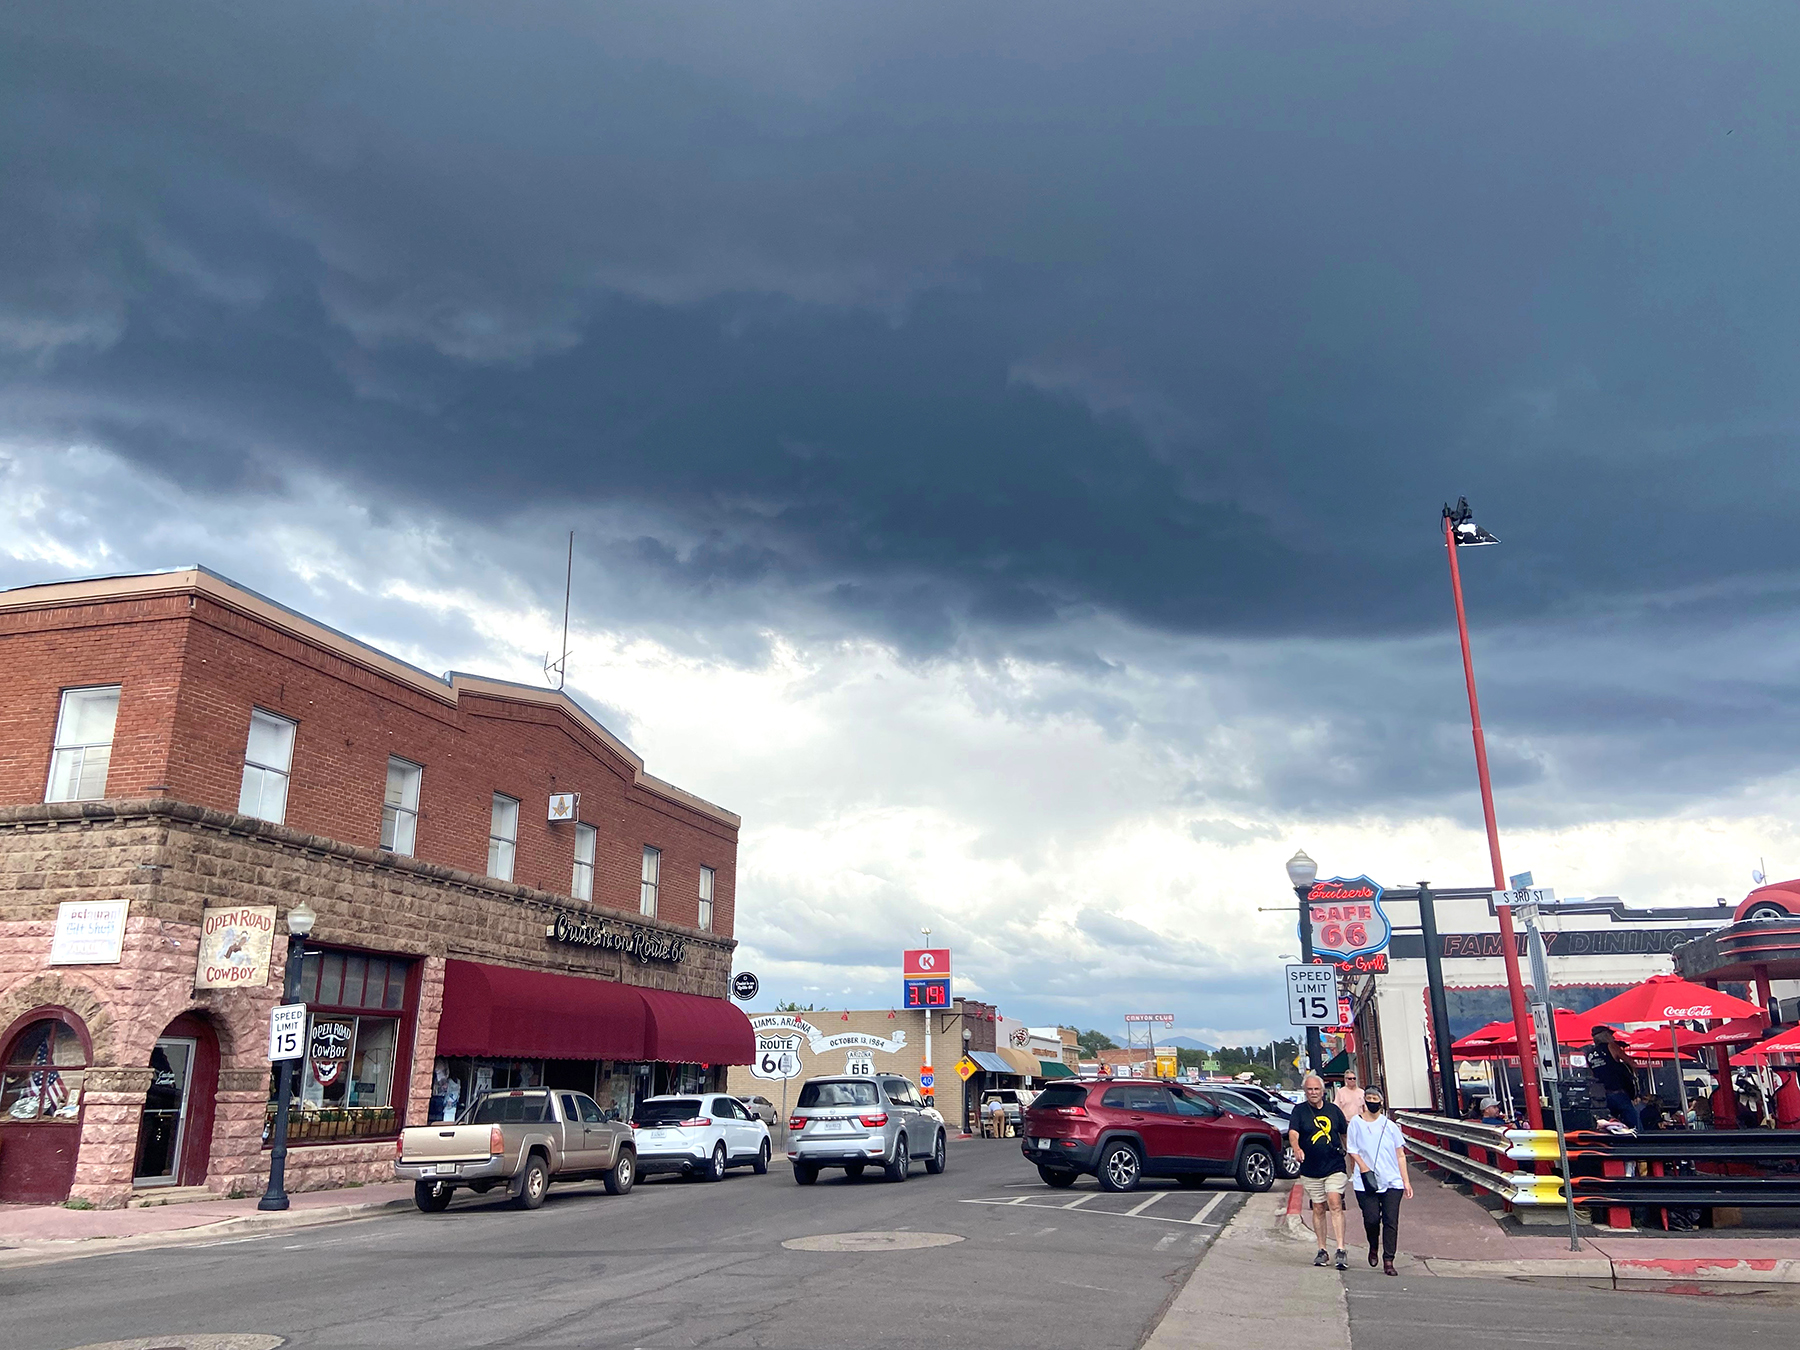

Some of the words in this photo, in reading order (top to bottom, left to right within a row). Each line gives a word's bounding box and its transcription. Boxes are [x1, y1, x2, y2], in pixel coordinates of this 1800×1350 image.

[1307, 882, 1374, 900] Cruiser's
[1503, 892, 1510, 904] S
[1513, 891, 1530, 903] 3RD
[1533, 890, 1544, 902] ST
[1310, 905, 1372, 922] CAFE
[205, 912, 239, 935] OPEN
[240, 910, 272, 932] ROAD
[1320, 922, 1368, 948] 66
[1568, 931, 1687, 954] DINING
[632, 931, 670, 963] Route
[671, 940, 687, 962] 66
[1355, 953, 1386, 972] Grill
[1290, 971, 1332, 981] SPEED
[1295, 984, 1327, 993] LIMIT
[1298, 996, 1329, 1019] 15
[1663, 1005, 1713, 1017] Coca-Cola
[274, 1010, 303, 1021] SPEED
[276, 1021, 299, 1032] LIMIT
[312, 1023, 332, 1040] OPEN
[333, 1023, 352, 1040] ROAD
[276, 1033, 297, 1053] 15
[760, 1040, 793, 1050] ROUTE
[829, 1036, 859, 1047] OCTOBER
[868, 1038, 885, 1048] 1984
[851, 1063, 869, 1075] 66
[922, 1077, 932, 1085] 40
